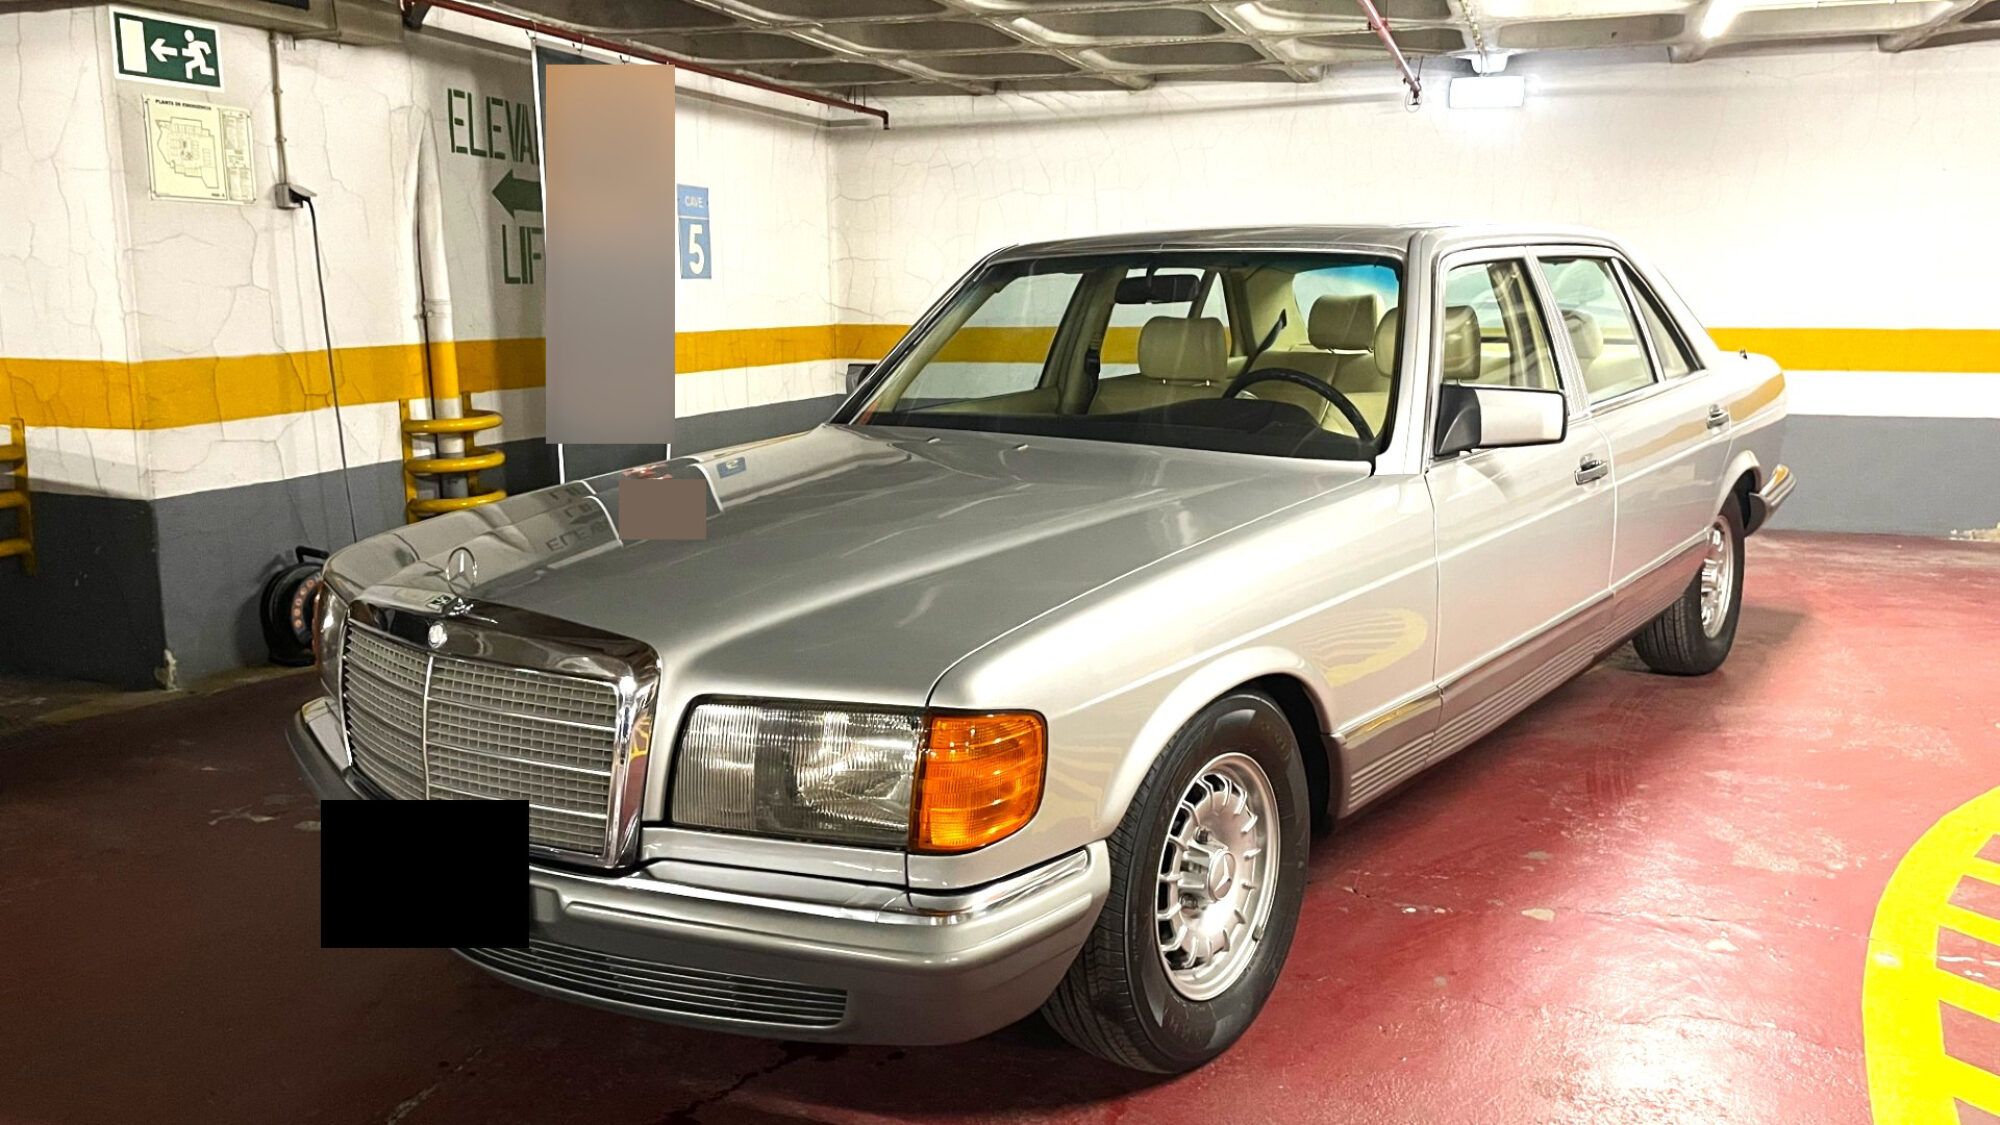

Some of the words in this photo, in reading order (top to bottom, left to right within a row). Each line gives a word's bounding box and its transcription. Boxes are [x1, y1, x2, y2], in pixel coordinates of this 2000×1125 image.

[447, 88, 540, 166] ELEVA
[684, 195, 704, 209] CAVE
[501, 223, 545, 285] LIF
[689, 223, 705, 275] 5
